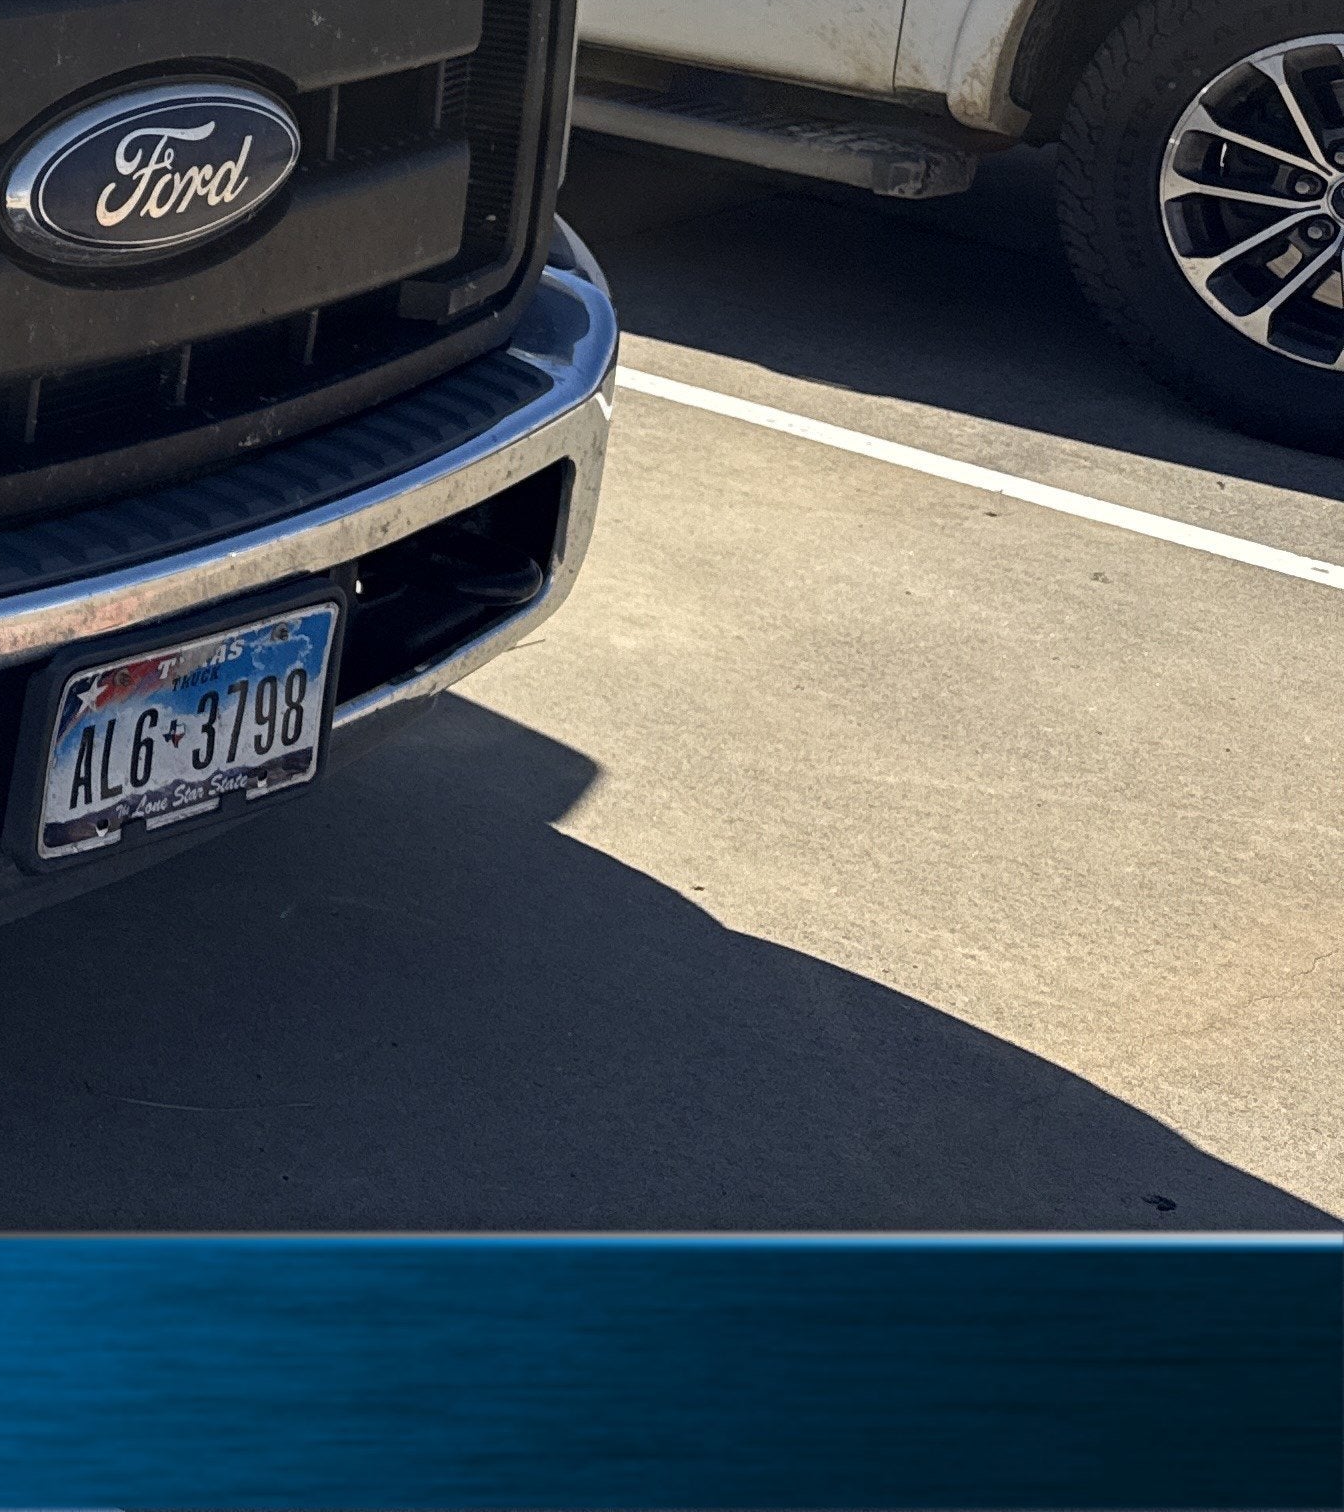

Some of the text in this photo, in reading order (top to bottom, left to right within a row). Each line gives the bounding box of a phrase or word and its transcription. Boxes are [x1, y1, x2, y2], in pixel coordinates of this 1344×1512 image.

[95, 119, 254, 227] Ford
[157, 638, 245, 680] TAS
[172, 664, 221, 692] TRUCK
[69, 668, 307, 810] AL6 3798
[131, 793, 169, 819] Lone
[172, 783, 205, 808] Star
[208, 773, 248, 796] State
